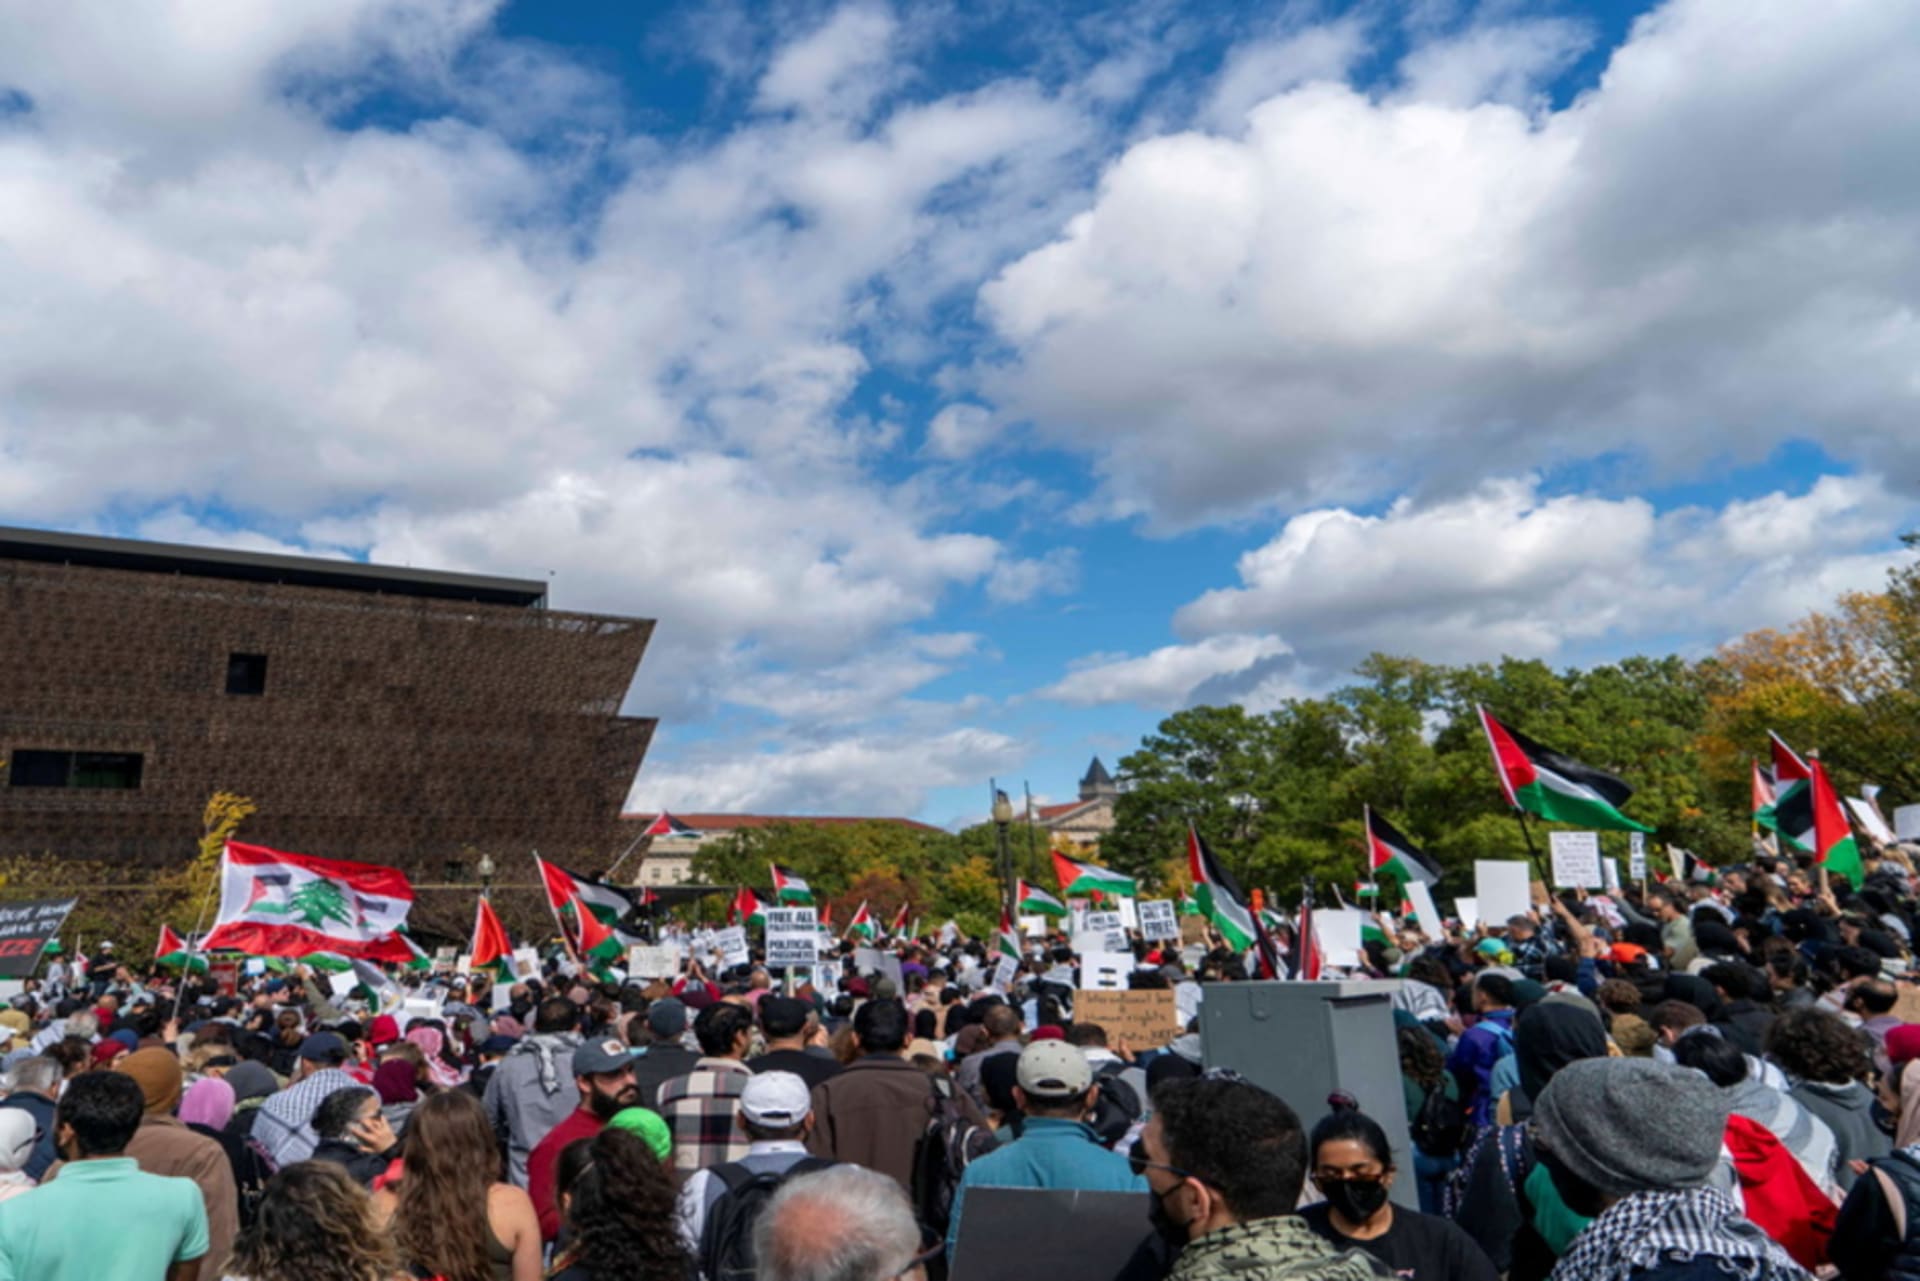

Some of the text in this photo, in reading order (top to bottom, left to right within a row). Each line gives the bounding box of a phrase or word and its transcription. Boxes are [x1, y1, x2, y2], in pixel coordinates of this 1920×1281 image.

[769, 911, 813, 923] FREE ALL
[769, 939, 814, 950] POLITICAL
